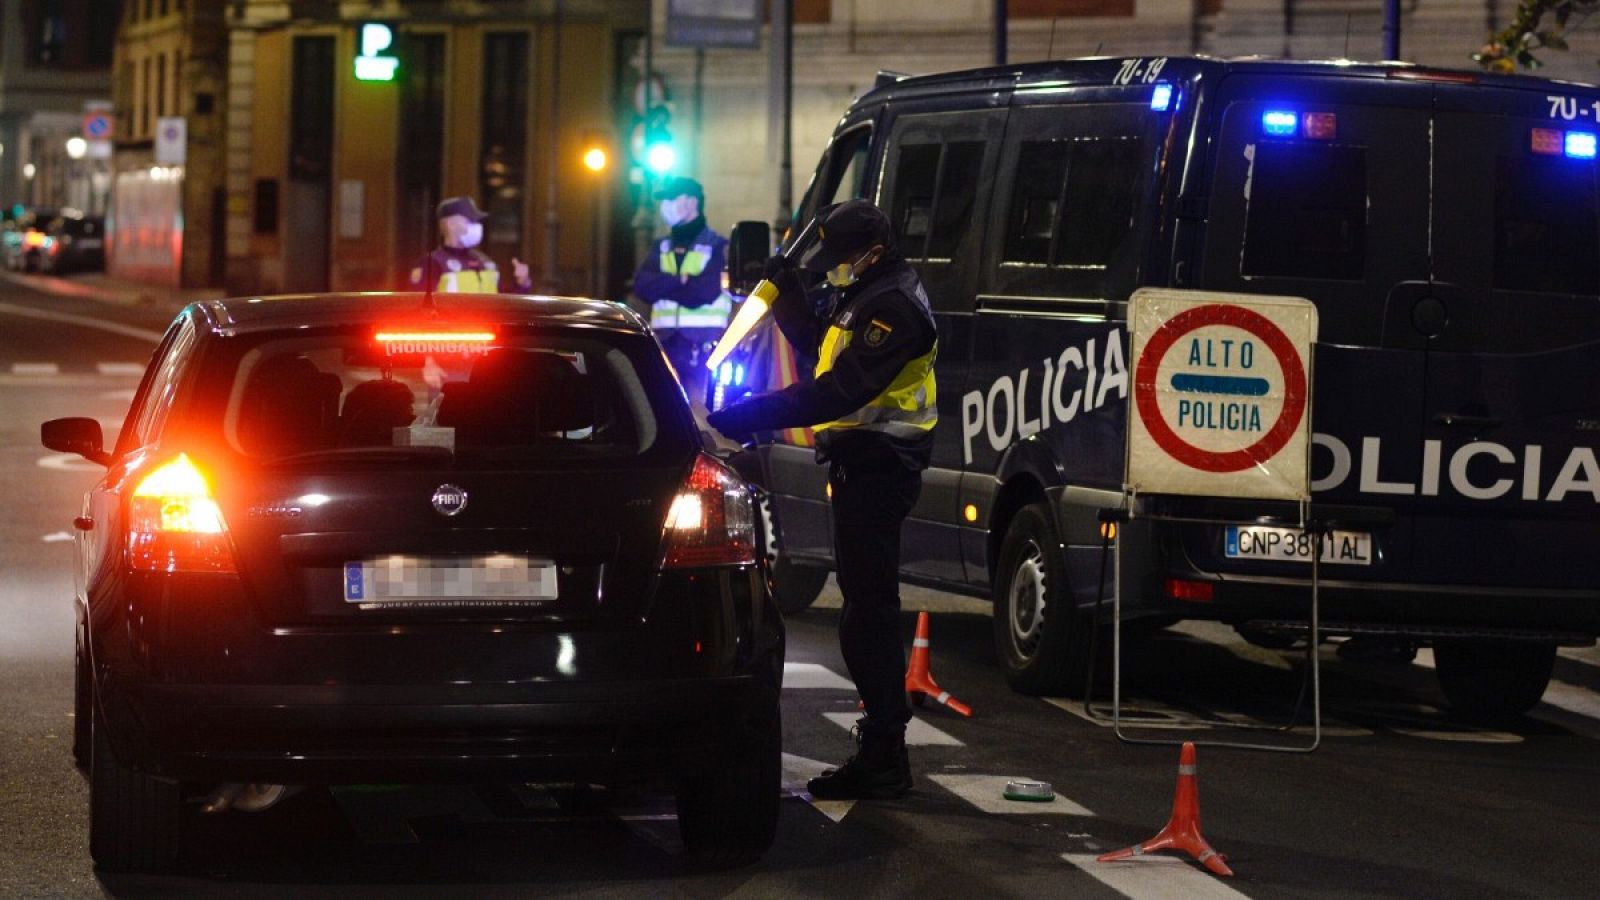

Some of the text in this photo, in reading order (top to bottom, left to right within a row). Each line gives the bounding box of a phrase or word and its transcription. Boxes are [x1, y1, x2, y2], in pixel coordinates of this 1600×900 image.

[363, 23, 392, 56] P
[1112, 57, 1168, 85] 7U-19
[1188, 338, 1254, 368] ALTO
[962, 328, 1128, 465] POLICIA
[1178, 401, 1262, 432] POLICIA
[1311, 433, 1600, 502] OLICIA
[438, 493, 461, 505] FIAT
[1238, 530, 1281, 556] CNP
[1340, 535, 1367, 561] AL
[351, 584, 360, 594] E
